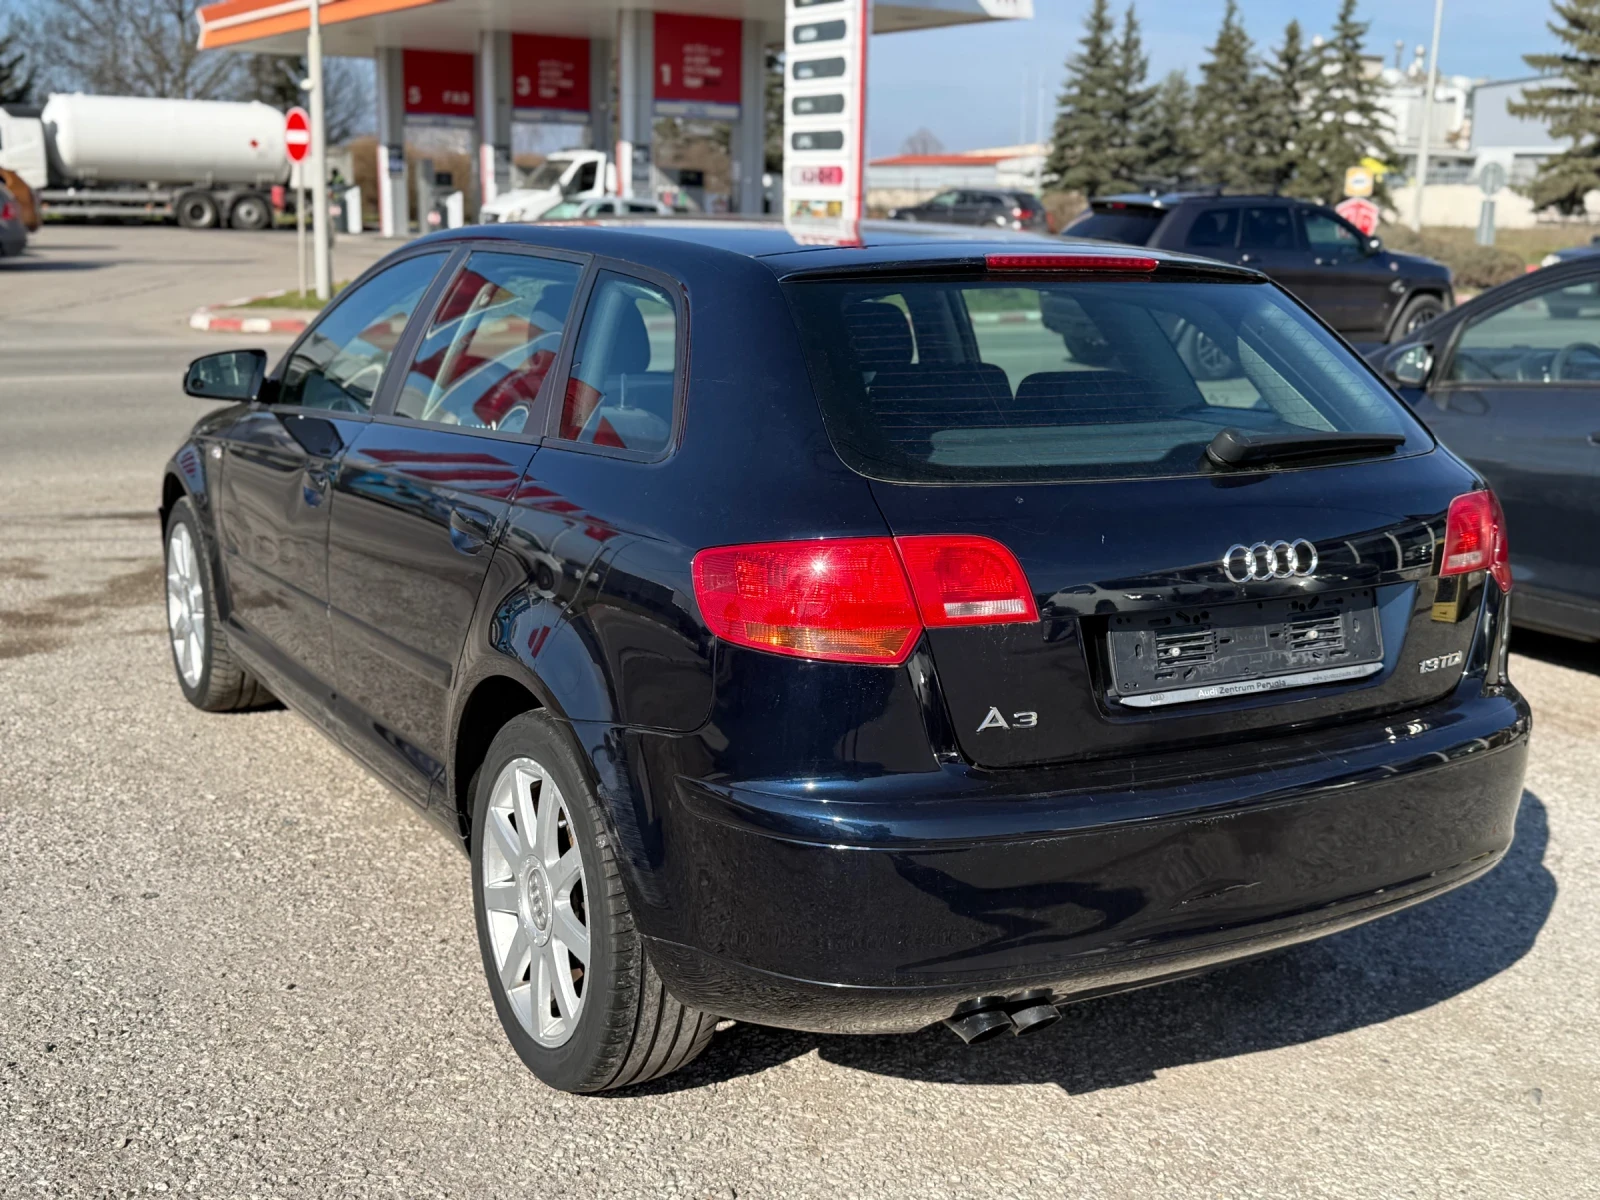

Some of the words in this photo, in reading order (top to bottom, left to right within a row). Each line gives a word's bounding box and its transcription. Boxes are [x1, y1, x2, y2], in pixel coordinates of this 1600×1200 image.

[516, 75, 531, 96] 3
[1198, 687, 1218, 698] Audi
[1219, 683, 1255, 695] Zentrum
[976, 706, 1038, 733] A3
